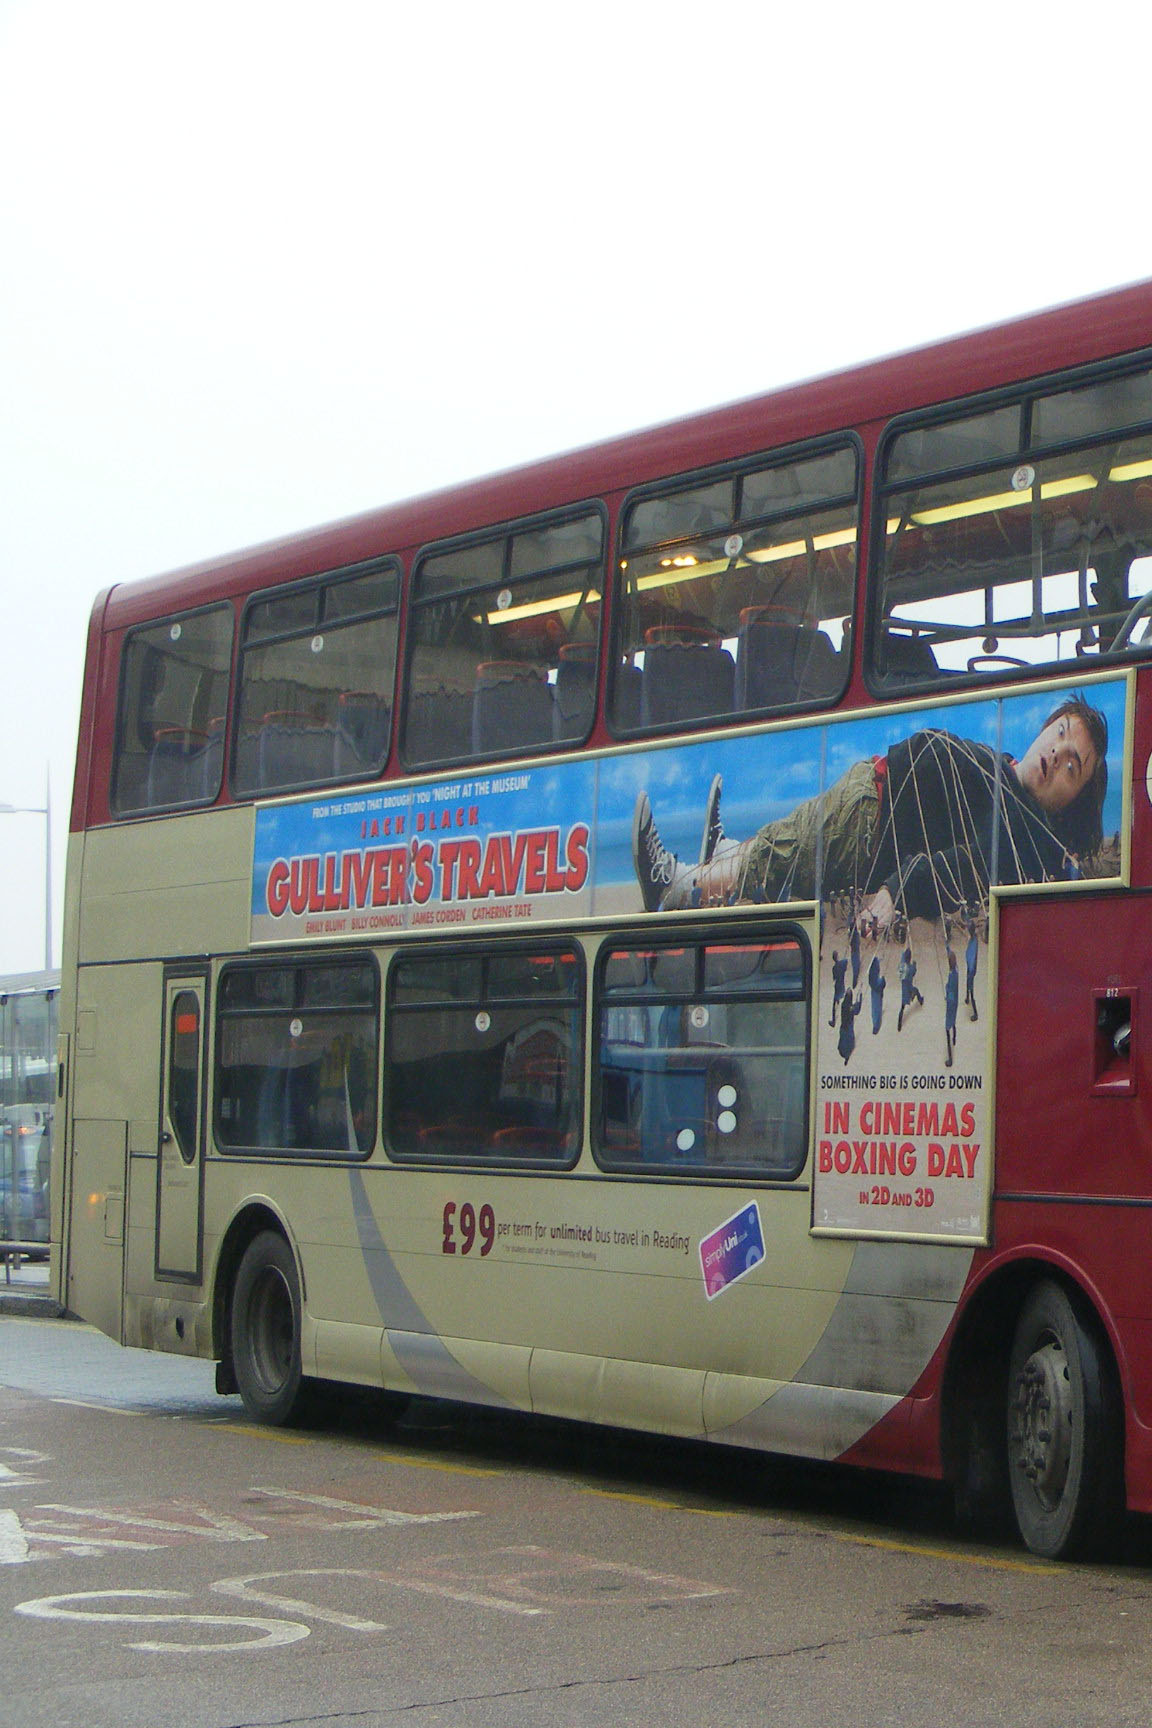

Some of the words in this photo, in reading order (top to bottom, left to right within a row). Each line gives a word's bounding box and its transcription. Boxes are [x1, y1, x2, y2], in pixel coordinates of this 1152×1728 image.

[312, 806, 328, 818] FROM
[331, 804, 342, 816] THE
[343, 801, 365, 814] STUDIO
[367, 798, 383, 811] THAT
[417, 791, 431, 803] YOU
[462, 783, 473, 797] AT
[475, 781, 490, 796] THE
[361, 816, 405, 838] JACK
[416, 806, 479, 832] BLACK
[266, 836, 435, 919] GULLIVER'S
[438, 822, 590, 902] TRAVELS
[306, 921, 323, 934] EMILY
[325, 919, 346, 932] BLUNT
[352, 917, 367, 930] BILLY
[412, 911, 434, 925] JAMES
[436, 908, 466, 922] CORDEN
[472, 905, 513, 921] CATHERINE
[514, 903, 533, 917] TATE
[821, 1075, 877, 1089] SOMETHING
[880, 1076, 897, 1089] BIG
[900, 1076, 909, 1089] IS
[911, 1075, 946, 1089] GOING
[949, 1075, 982, 1089] DOWN
[824, 1101, 850, 1135] IN
[859, 1101, 976, 1137] CINEMAS
[819, 1141, 917, 1176] BOXING
[928, 1143, 981, 1178] DAY
[859, 1191, 869, 1204] IN
[871, 1186, 890, 1205] 2D
[891, 1193, 912, 1206] AND
[914, 1187, 934, 1207] 3D
[442, 1201, 495, 1257] £99
[497, 1223, 511, 1239] per
[513, 1223, 532, 1236] term
[535, 1221, 546, 1240] for
[550, 1223, 592, 1242] unlimited
[595, 1227, 610, 1243] bus
[613, 1230, 639, 1246] travel
[641, 1231, 649, 1247] in
[653, 1231, 691, 1255] Reading
